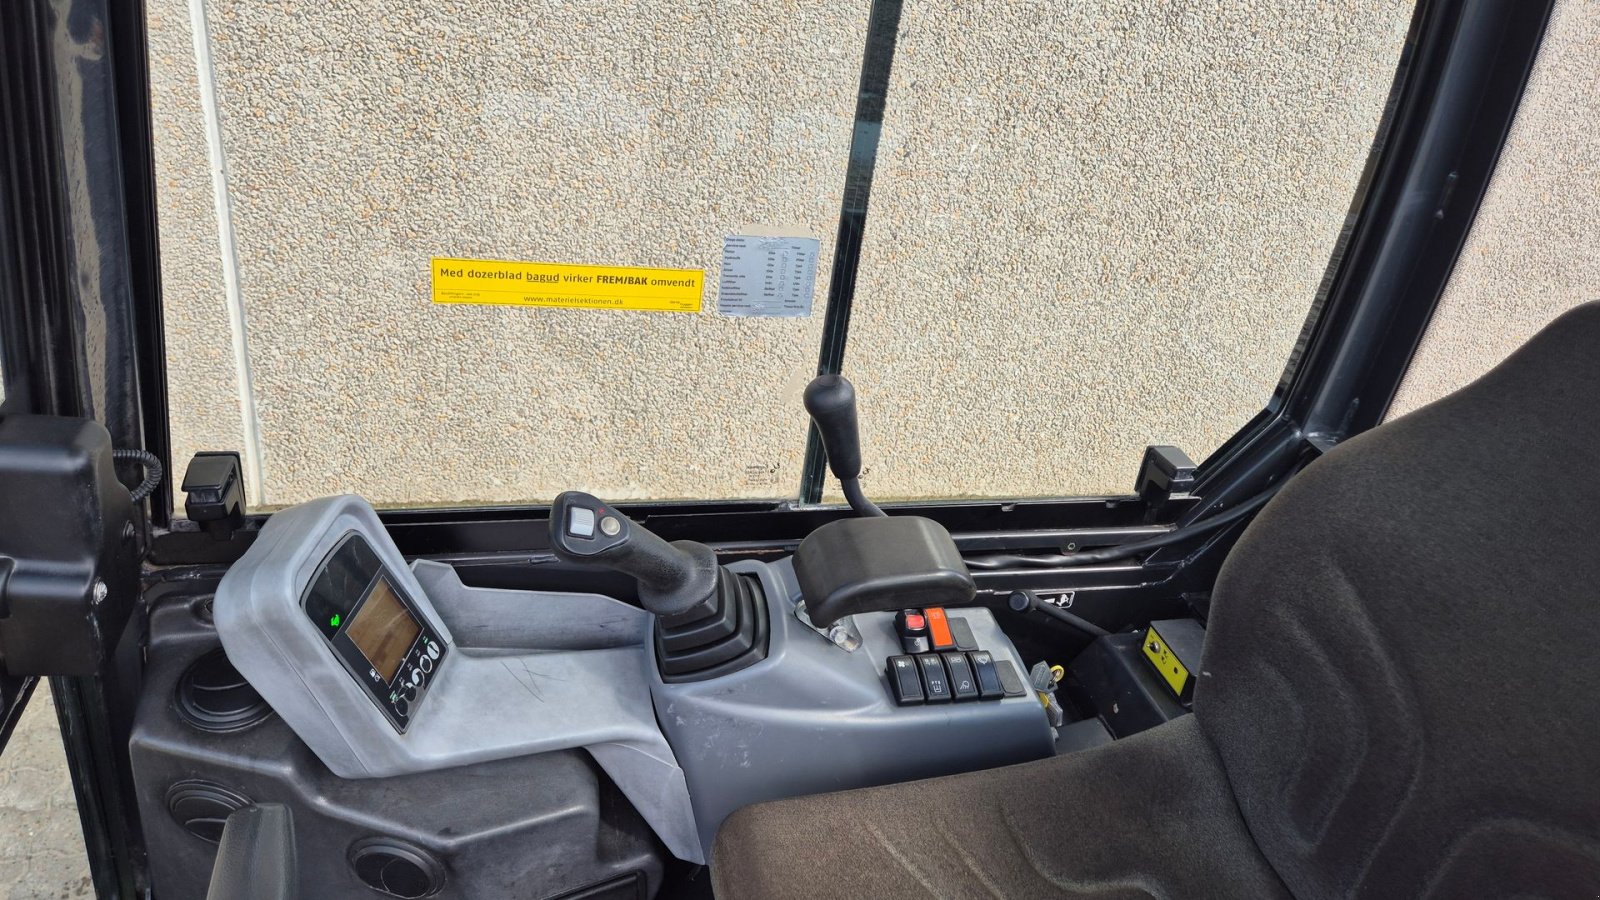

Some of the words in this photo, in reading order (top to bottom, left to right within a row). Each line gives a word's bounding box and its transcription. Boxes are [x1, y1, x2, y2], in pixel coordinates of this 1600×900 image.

[440, 268, 463, 278] Med
[467, 269, 522, 280] dozerblad
[526, 272, 560, 283] bagud
[563, 273, 593, 284] virker
[596, 275, 648, 286] FREM/BAK
[650, 278, 696, 288] omvendt
[523, 294, 624, 306] www.materielsektionen.dk
